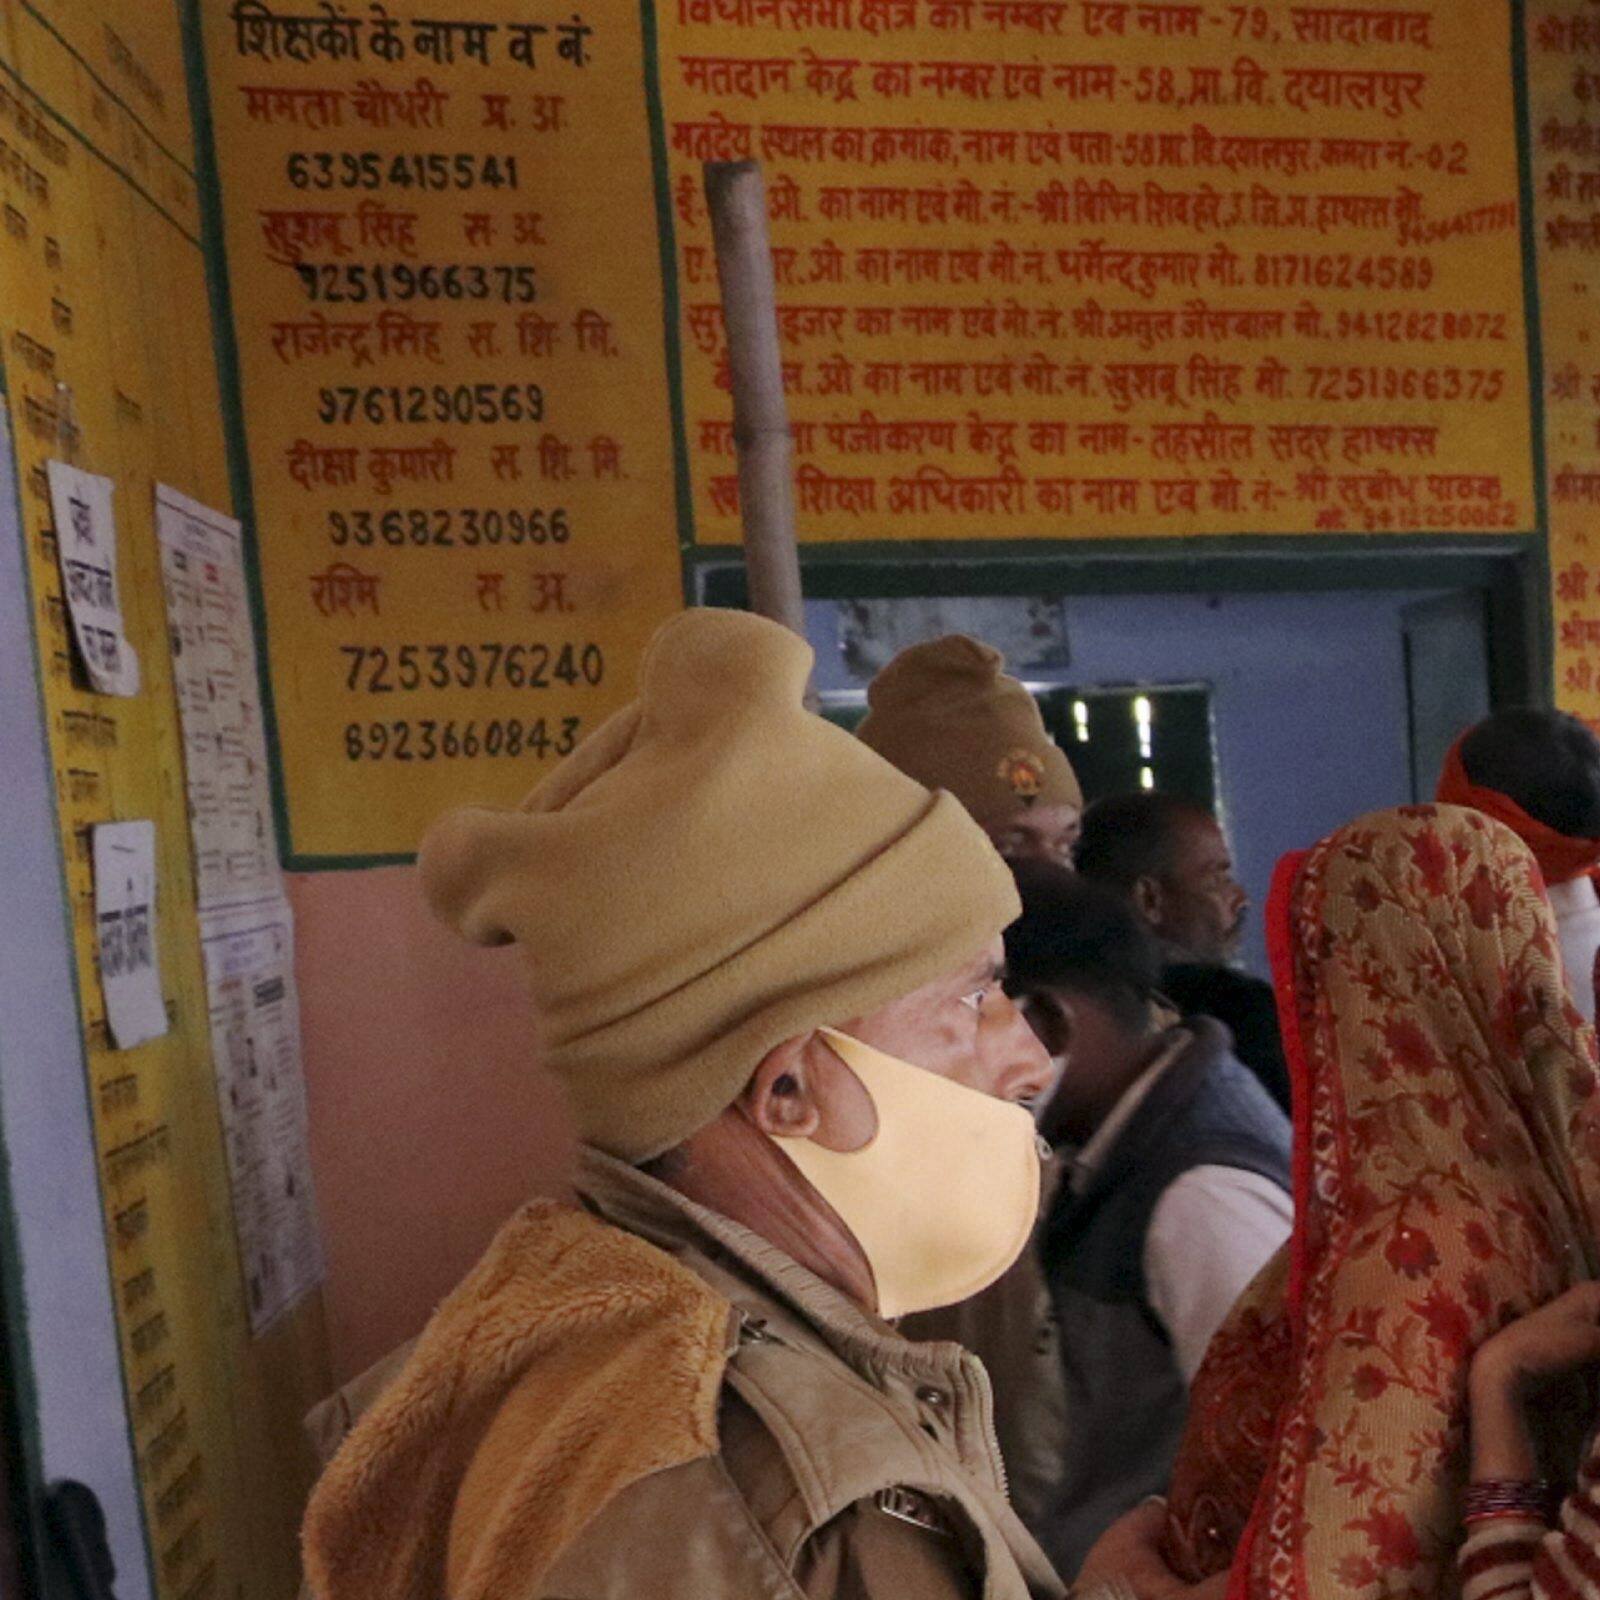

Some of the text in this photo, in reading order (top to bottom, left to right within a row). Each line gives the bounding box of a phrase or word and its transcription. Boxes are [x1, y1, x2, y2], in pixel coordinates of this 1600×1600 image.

[232, 2, 362, 63] शिक्षकों
[369, 4, 404, 63] के
[411, 20, 497, 65] नाम
[506, 24, 547, 68] व
[1291, 7, 1433, 50] सादाबाद
[239, 84, 345, 129] ममता
[351, 76, 449, 128] चौधरी
[679, 54, 796, 100] मतदान
[869, 60, 913, 99] का
[920, 60, 995, 101] नम्बर
[1053, 64, 1115, 101] नाम
[1283, 68, 1425, 118] दयालपुर
[761, 123, 827, 161] स्थल
[962, 130, 1017, 163] नाम
[287, 152, 519, 190] 6395415541
[819, 187, 853, 221] का
[857, 188, 911, 222] नाम
[856, 248, 893, 288] का
[893, 249, 943, 284] नाम
[1255, 255, 1434, 290] 8171624589
[270, 311, 374, 368] राजेन्द्र
[855, 306, 893, 336] का
[900, 306, 954, 339] नाम
[864, 363, 902, 396] का
[908, 362, 964, 396] नाम
[1304, 366, 1507, 402] 7251966375
[317, 383, 545, 426] 9761290569
[1027, 421, 1067, 455] का
[1150, 411, 1255, 463] तहसील
[1267, 424, 1333, 462] सदर
[285, 439, 359, 492] दीक्षा
[366, 438, 456, 496] कुमारी
[795, 462, 876, 516] शिक्षा
[888, 463, 1026, 516] अधिकारी
[1034, 477, 1073, 515] का
[1081, 478, 1142, 515] नाम
[327, 508, 570, 548] 9368230966
[339, 642, 605, 694] 7253976240
[344, 716, 581, 762] 8923660843
